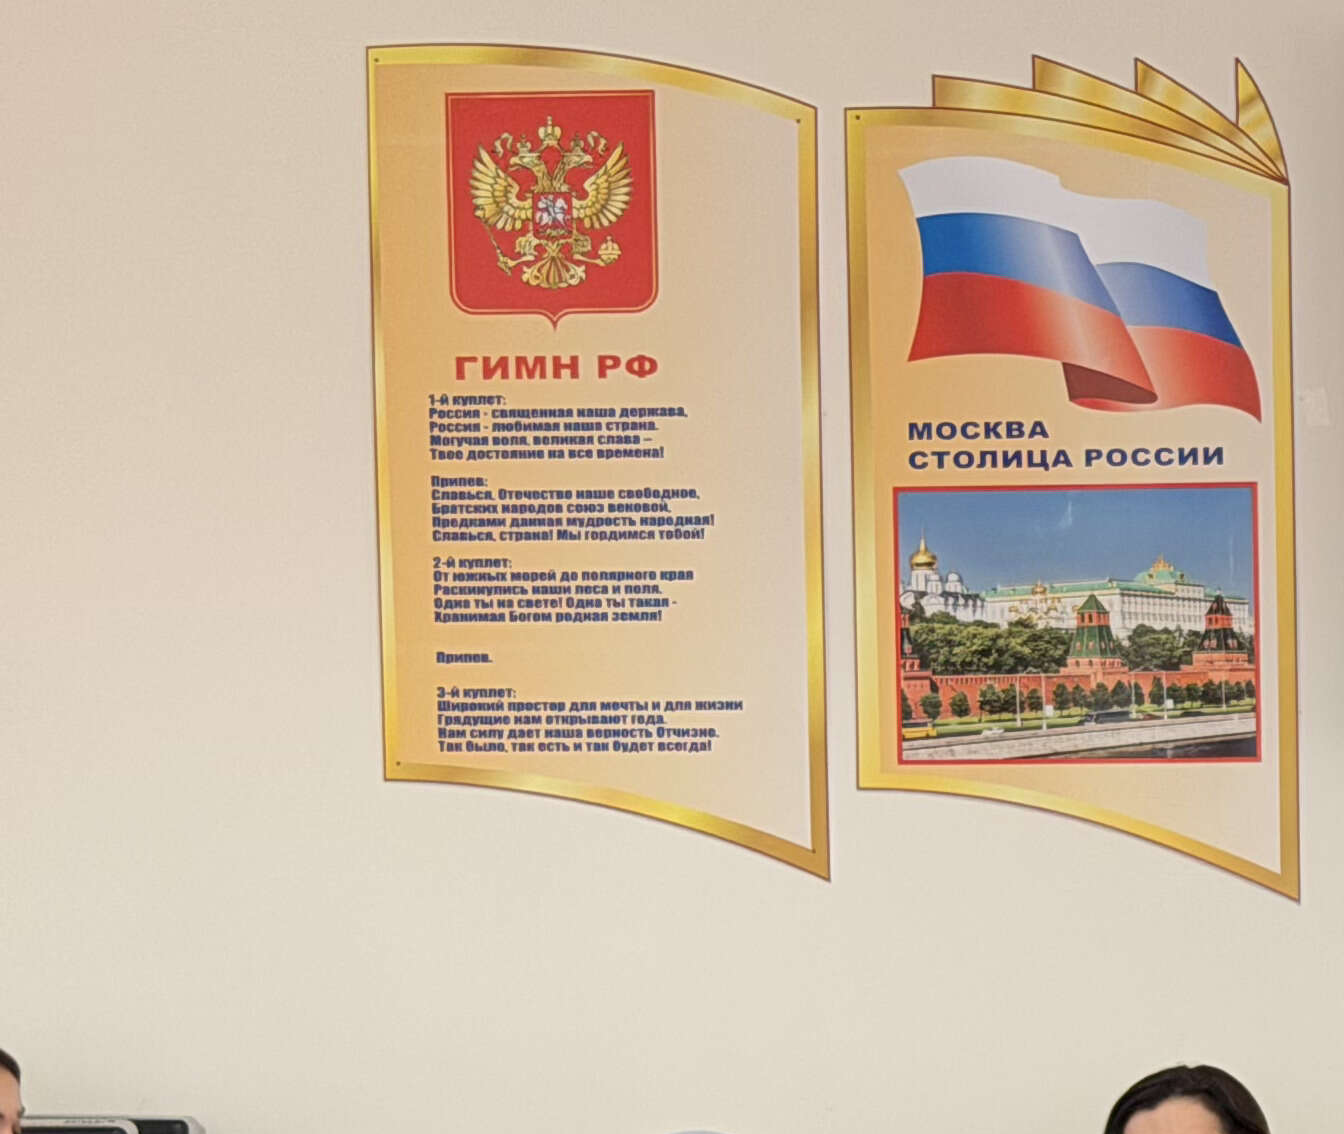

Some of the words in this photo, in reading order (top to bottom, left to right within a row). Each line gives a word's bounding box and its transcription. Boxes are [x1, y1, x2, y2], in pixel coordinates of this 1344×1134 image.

[455, 355, 580, 381] ГИМН
[597, 354, 658, 379] РФ
[908, 420, 1049, 441] МОСКВА
[908, 449, 1073, 472] СТОЛИЦА
[1084, 446, 1224, 468] РОССИИ
